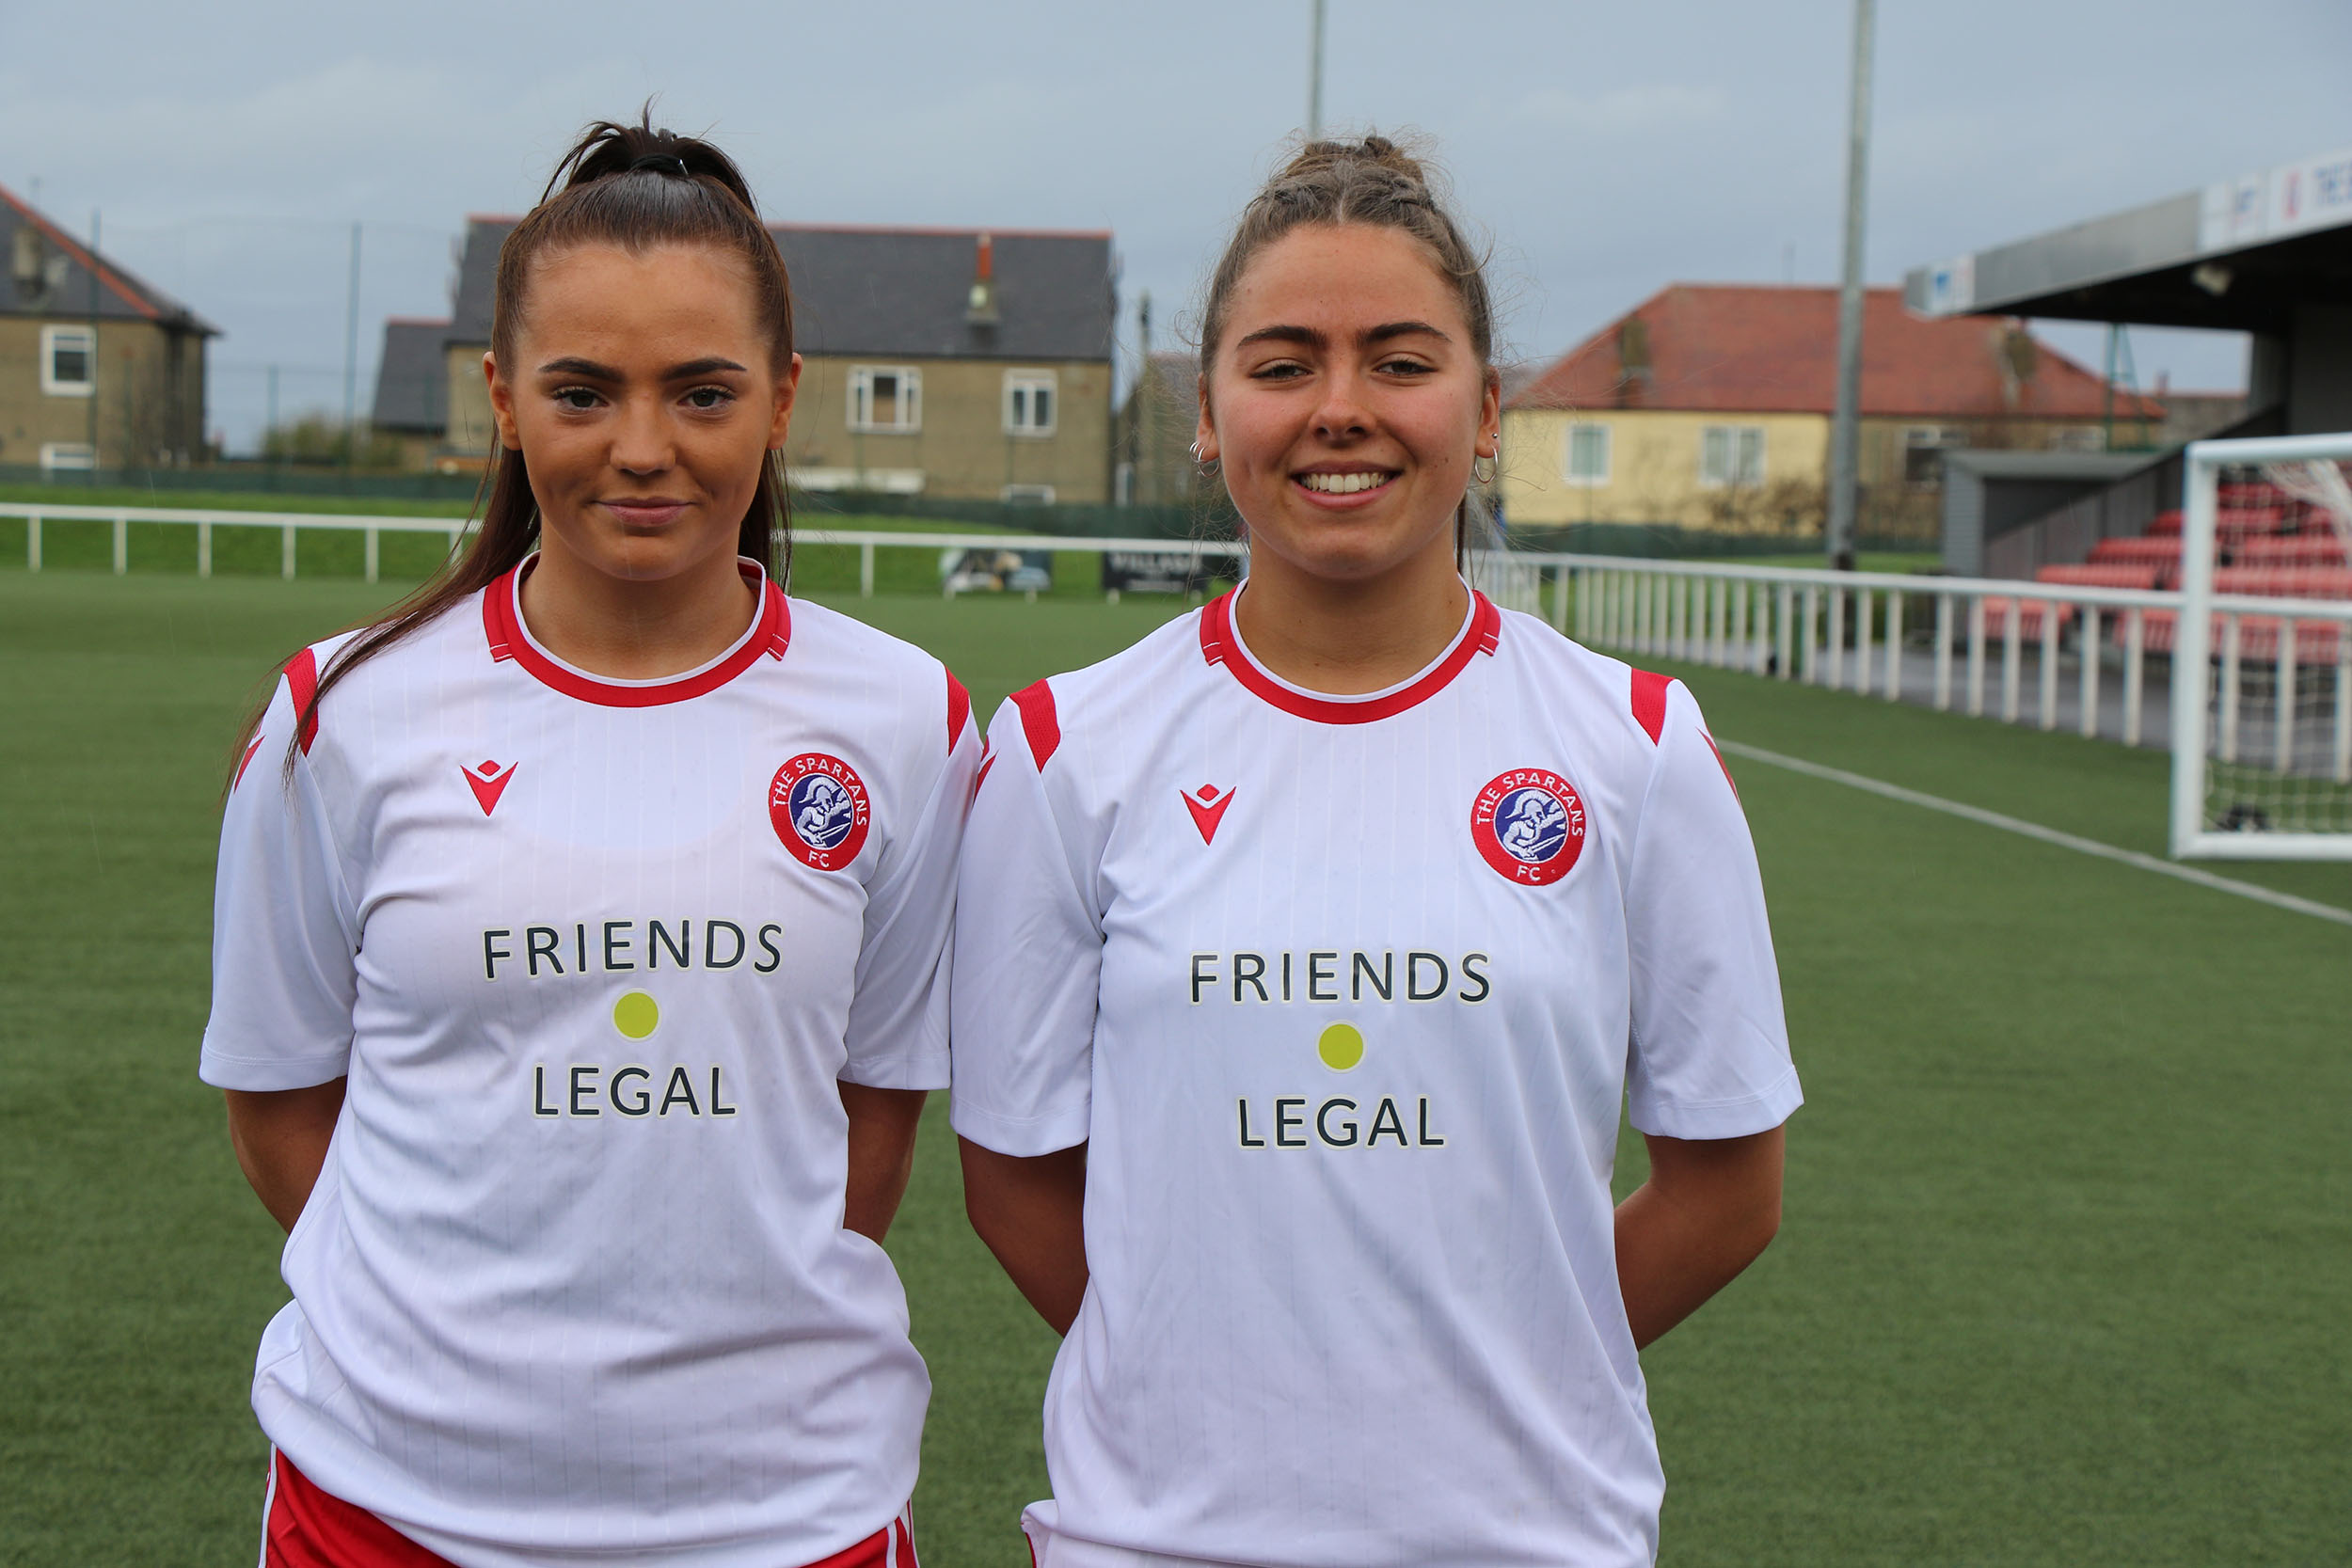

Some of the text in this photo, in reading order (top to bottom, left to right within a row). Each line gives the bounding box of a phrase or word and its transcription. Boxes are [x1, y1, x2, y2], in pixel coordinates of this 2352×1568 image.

[772, 757, 867, 826] THE SPARTANS
[1476, 771, 1583, 836] THE SPARTANS
[808, 849, 830, 868] FC
[1517, 864, 1541, 881] FC
[483, 918, 783, 979] FRIENDS
[1190, 951, 1491, 1003] FRIENDS
[534, 1065, 737, 1117] LEGAL
[1238, 1097, 1445, 1148] LEGAL
